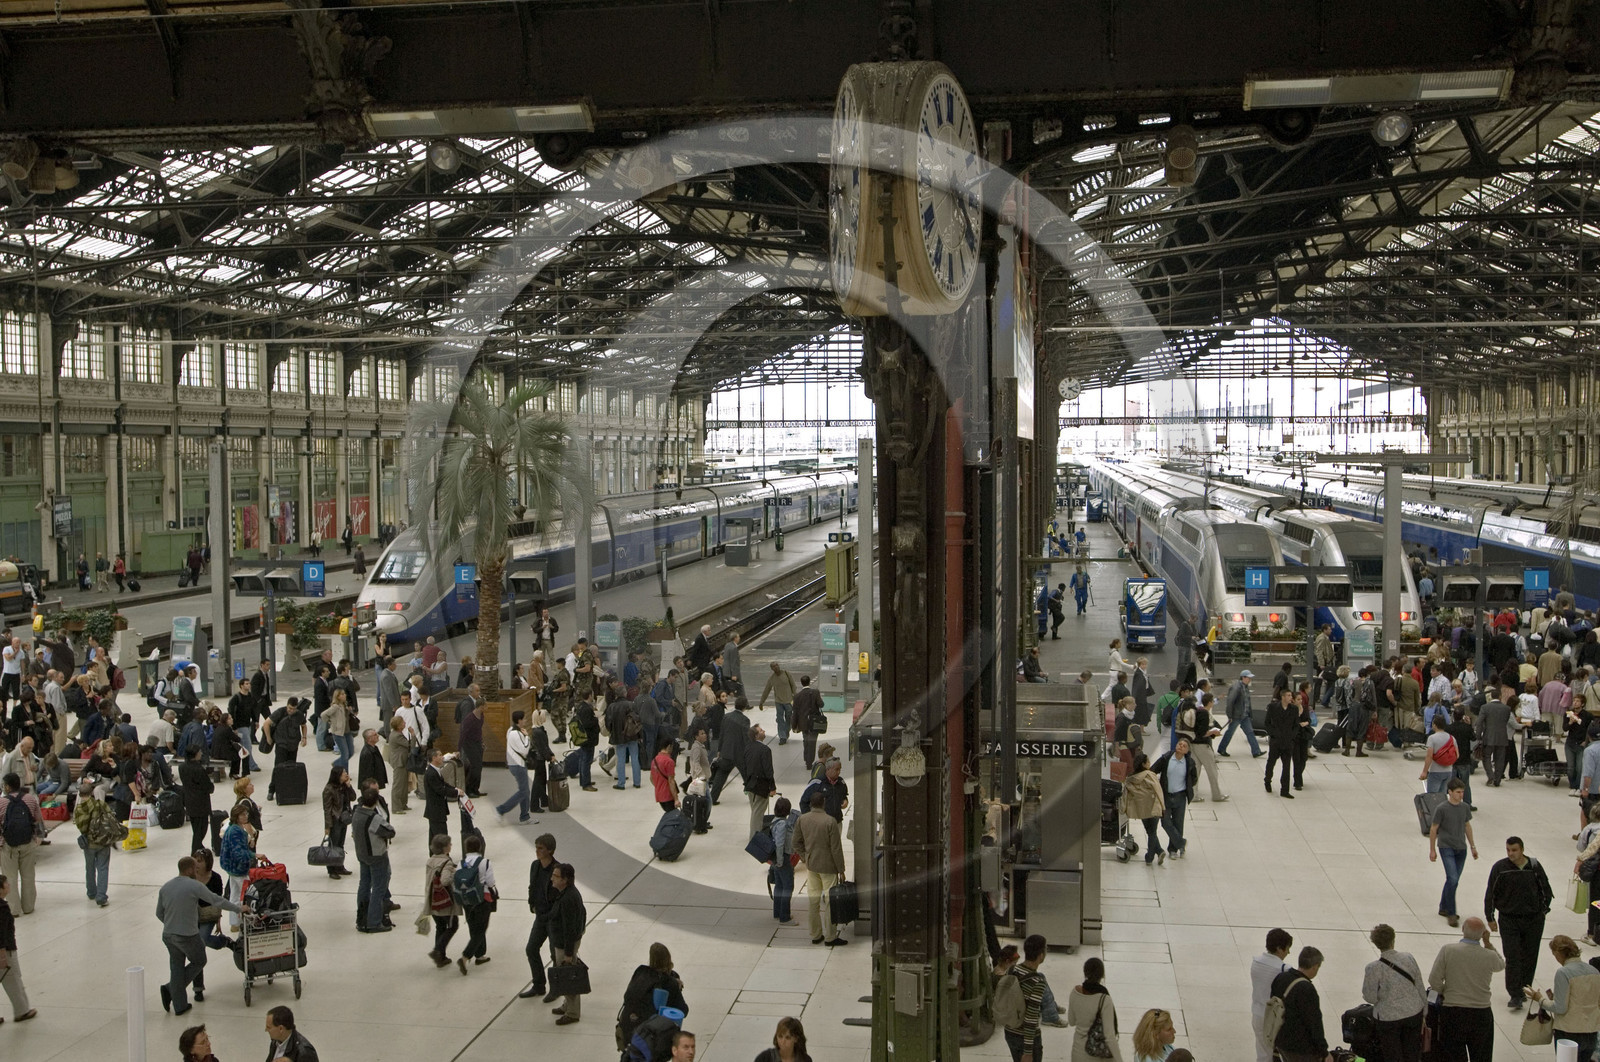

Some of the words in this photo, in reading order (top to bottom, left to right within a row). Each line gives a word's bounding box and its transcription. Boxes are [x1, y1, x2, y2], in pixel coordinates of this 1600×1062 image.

[309, 567, 318, 578] D
[461, 569, 468, 581] E
[1252, 573, 1262, 585] H
[986, 742, 1088, 756] PAISSERIES
